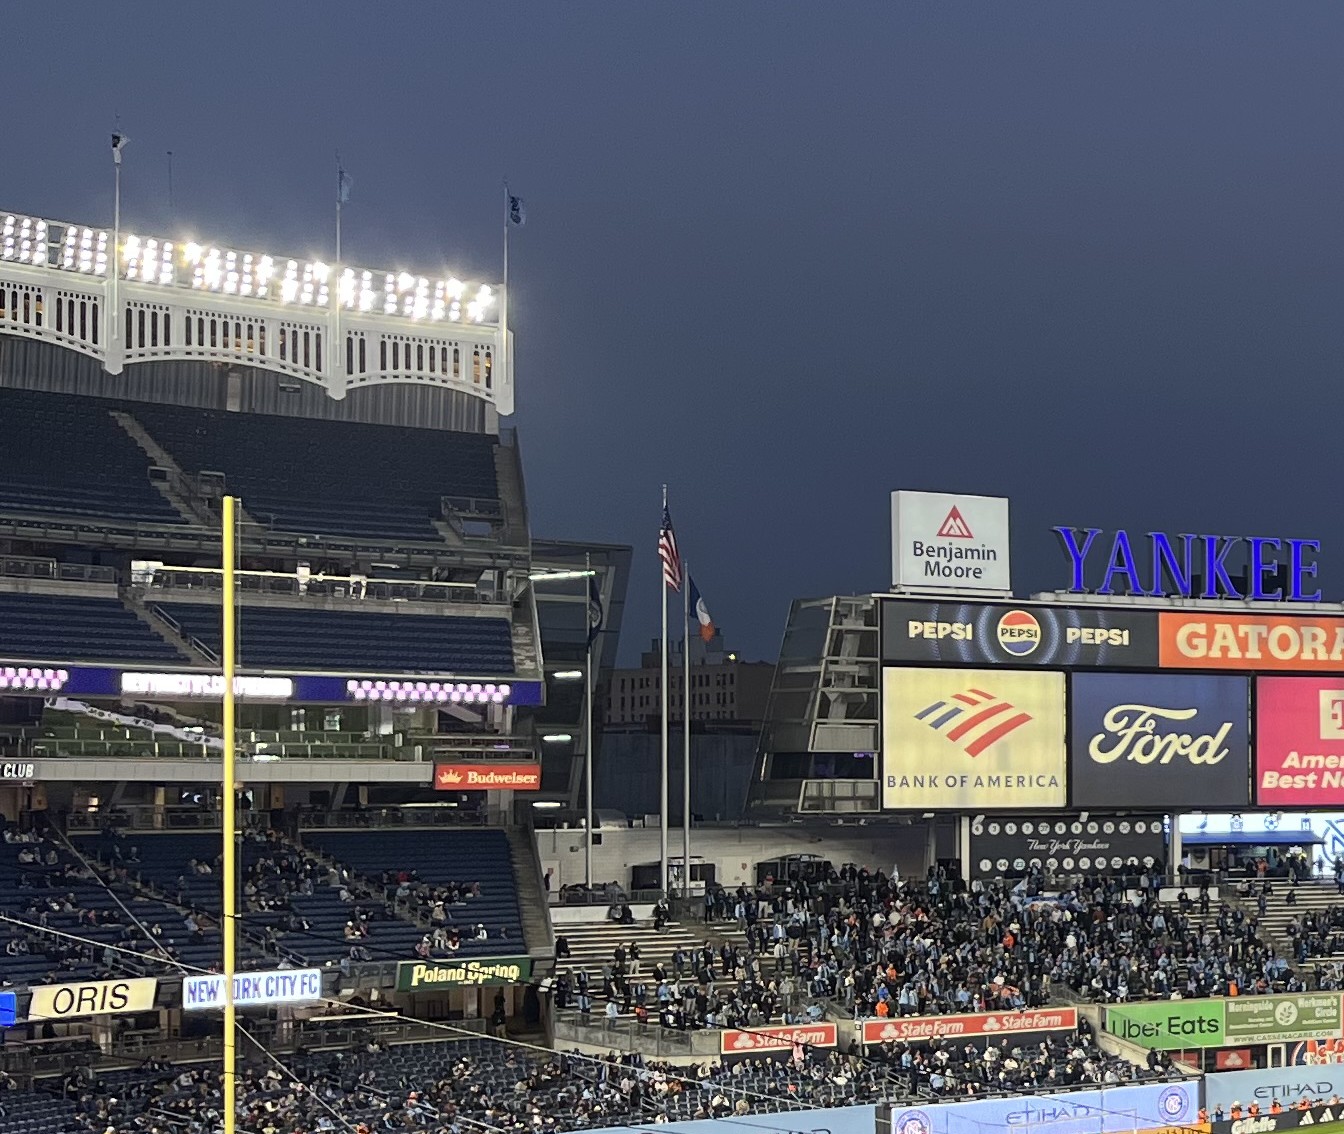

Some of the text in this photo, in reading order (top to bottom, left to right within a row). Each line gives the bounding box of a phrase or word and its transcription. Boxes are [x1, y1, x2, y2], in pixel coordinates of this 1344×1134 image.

[913, 541, 997, 563] Benjamin
[924, 561, 983, 579] Moore
[1053, 526, 1322, 602] YANKEE
[908, 621, 973, 640] PEPSI
[1000, 626, 1038, 638] PEPSI
[1066, 627, 1129, 646] PEPSI
[1089, 704, 1233, 765] Ford
[3, 762, 34, 778] CLUB
[467, 770, 537, 785] Budweiser
[887, 775, 1059, 788] BANK OF AMERICA
[1262, 771, 1317, 788] Best
[1027, 839, 1109, 854] New York Yankees
[411, 962, 520, 987] Poland Spring
[188, 974, 318, 1003] NEW ORK CITY FC
[52, 985, 129, 1015] ORIS
[1001, 1013, 1062, 1029] StateFarm
[1315, 1008, 1337, 1017] Circle
[900, 1020, 963, 1037] StateFarm
[1112, 1016, 1219, 1038] Uber Eats
[756, 1028, 825, 1046] StateFarm
[1254, 1082, 1333, 1098] ETIHAD
[1006, 1104, 1090, 1125] ETIHAD
